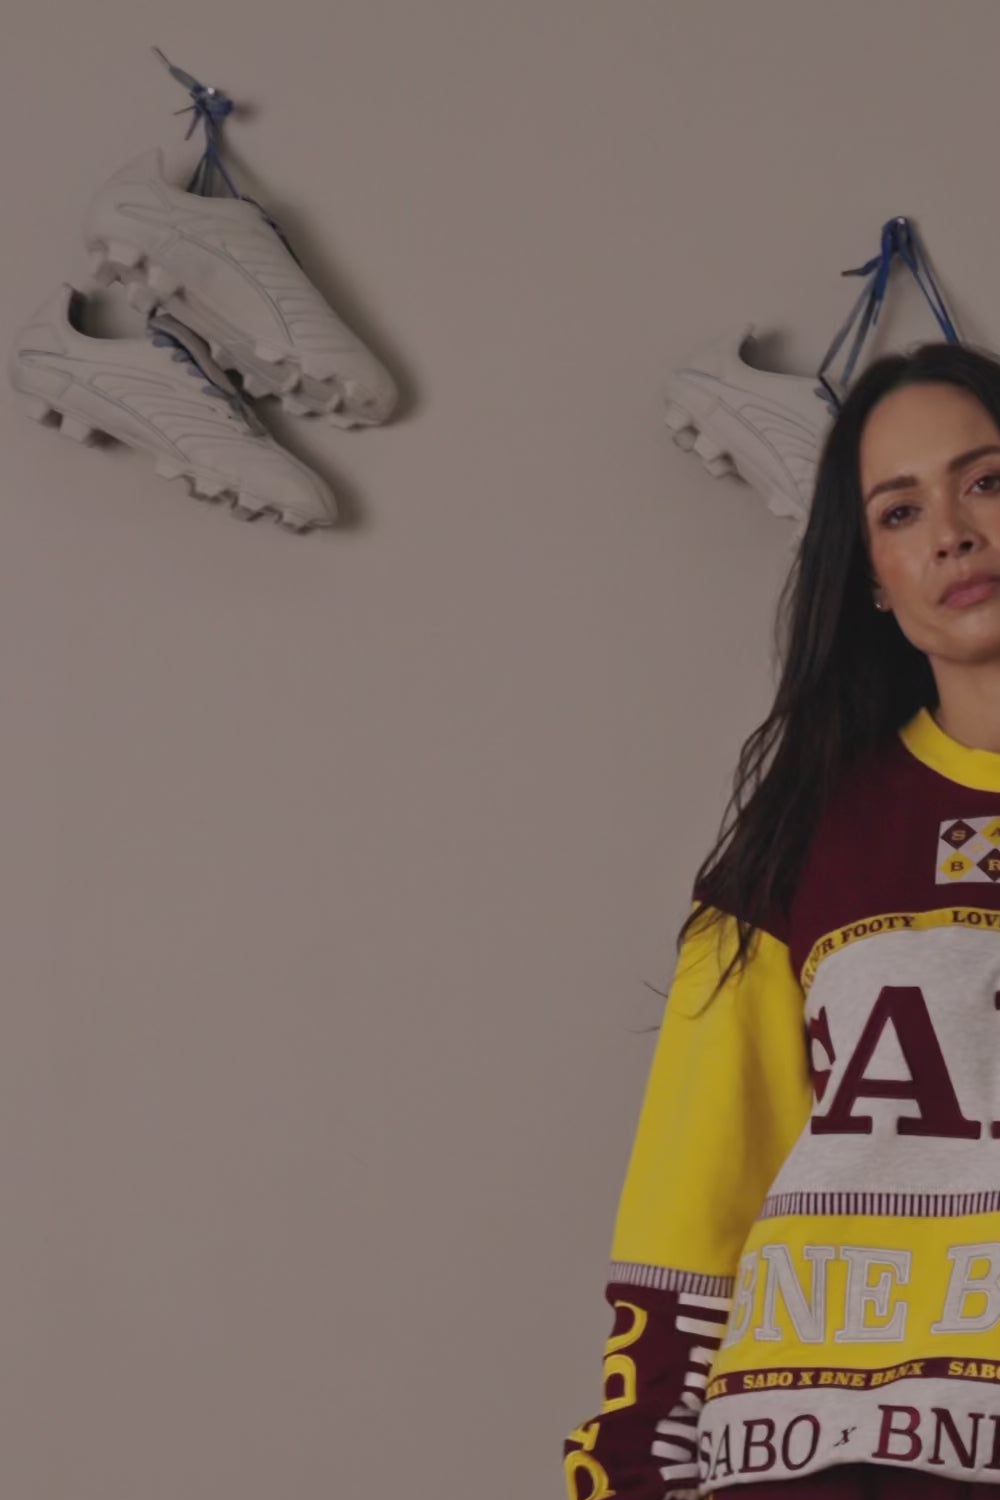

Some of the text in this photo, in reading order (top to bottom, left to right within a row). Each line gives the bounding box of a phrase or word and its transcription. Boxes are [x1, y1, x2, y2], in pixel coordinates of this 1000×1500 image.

[841, 916, 915, 944] FOOTY
[743, 1371, 793, 1390] SABO
[797, 1372, 815, 1385] X
[818, 1371, 866, 1387] BNE
[699, 1414, 821, 1484] SABO
